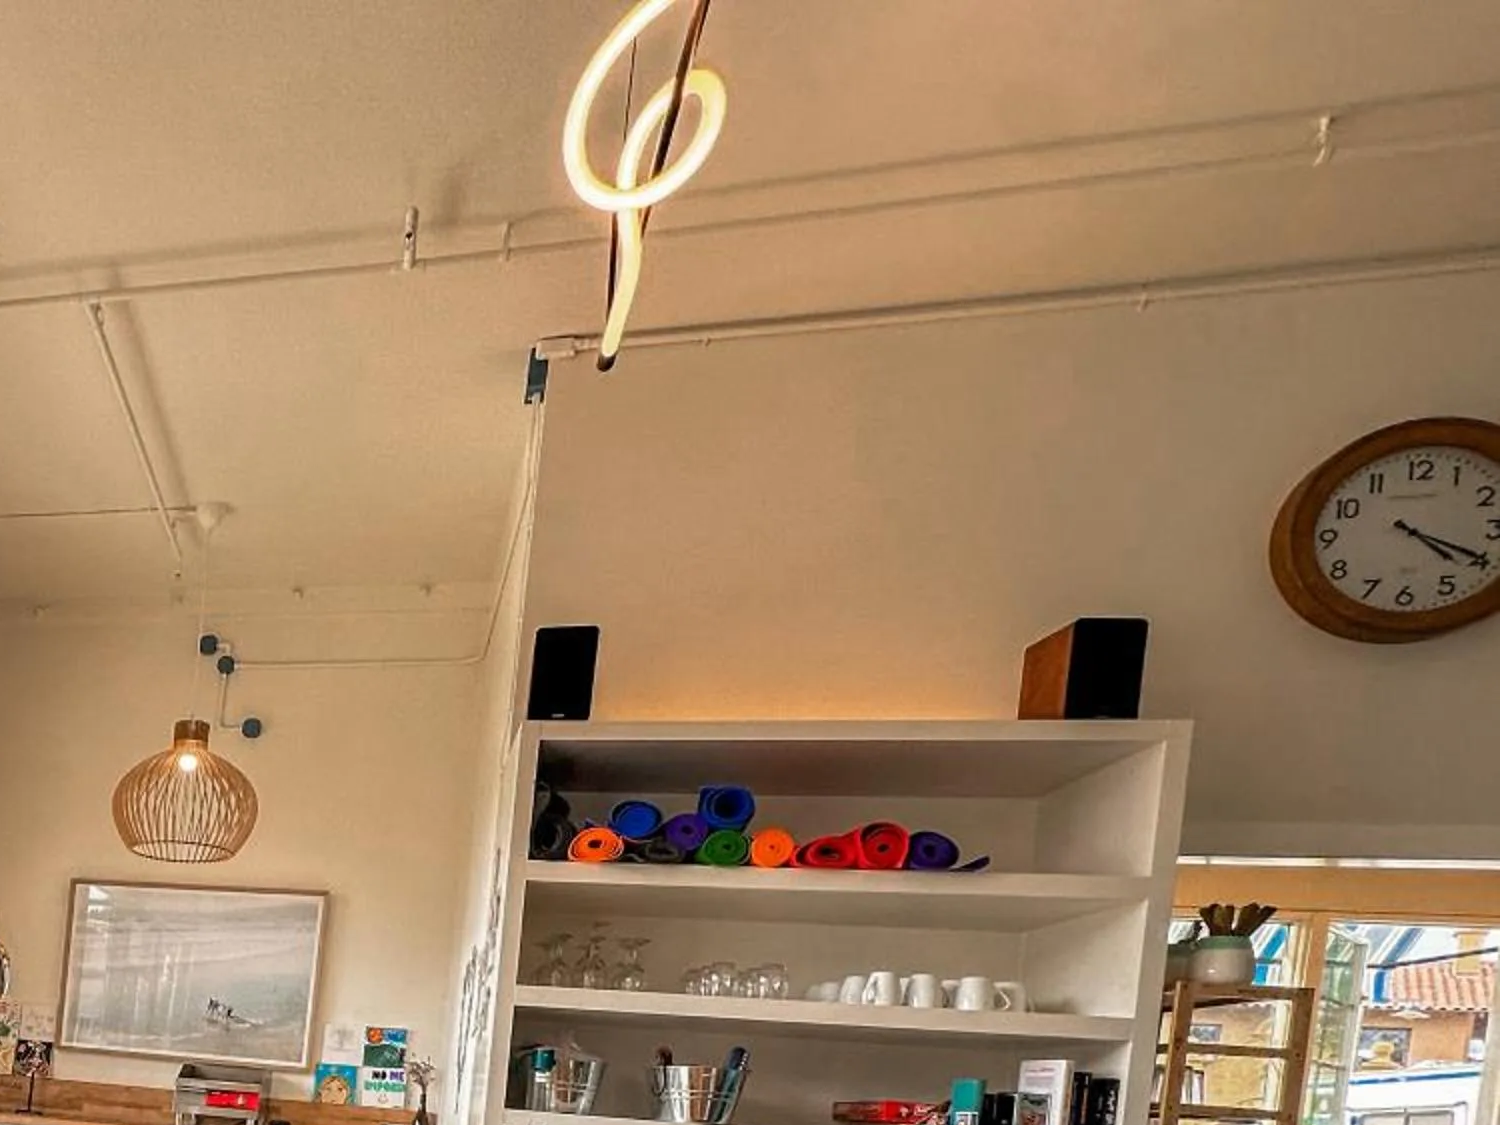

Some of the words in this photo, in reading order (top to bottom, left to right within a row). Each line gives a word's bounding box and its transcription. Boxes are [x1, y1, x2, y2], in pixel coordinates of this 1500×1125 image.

[1408, 460, 1434, 480] 12
[1453, 465, 1461, 486] 1
[1369, 473, 1384, 494] 11
[1476, 486, 1496, 507] 2
[1337, 498, 1360, 519] 10
[1319, 529, 1338, 550] 9
[1486, 519, 1500, 541] 3
[1330, 560, 1347, 580] 8
[1361, 579, 1383, 600] 7
[1395, 585, 1414, 606] 6
[1437, 575, 1456, 596] 5
